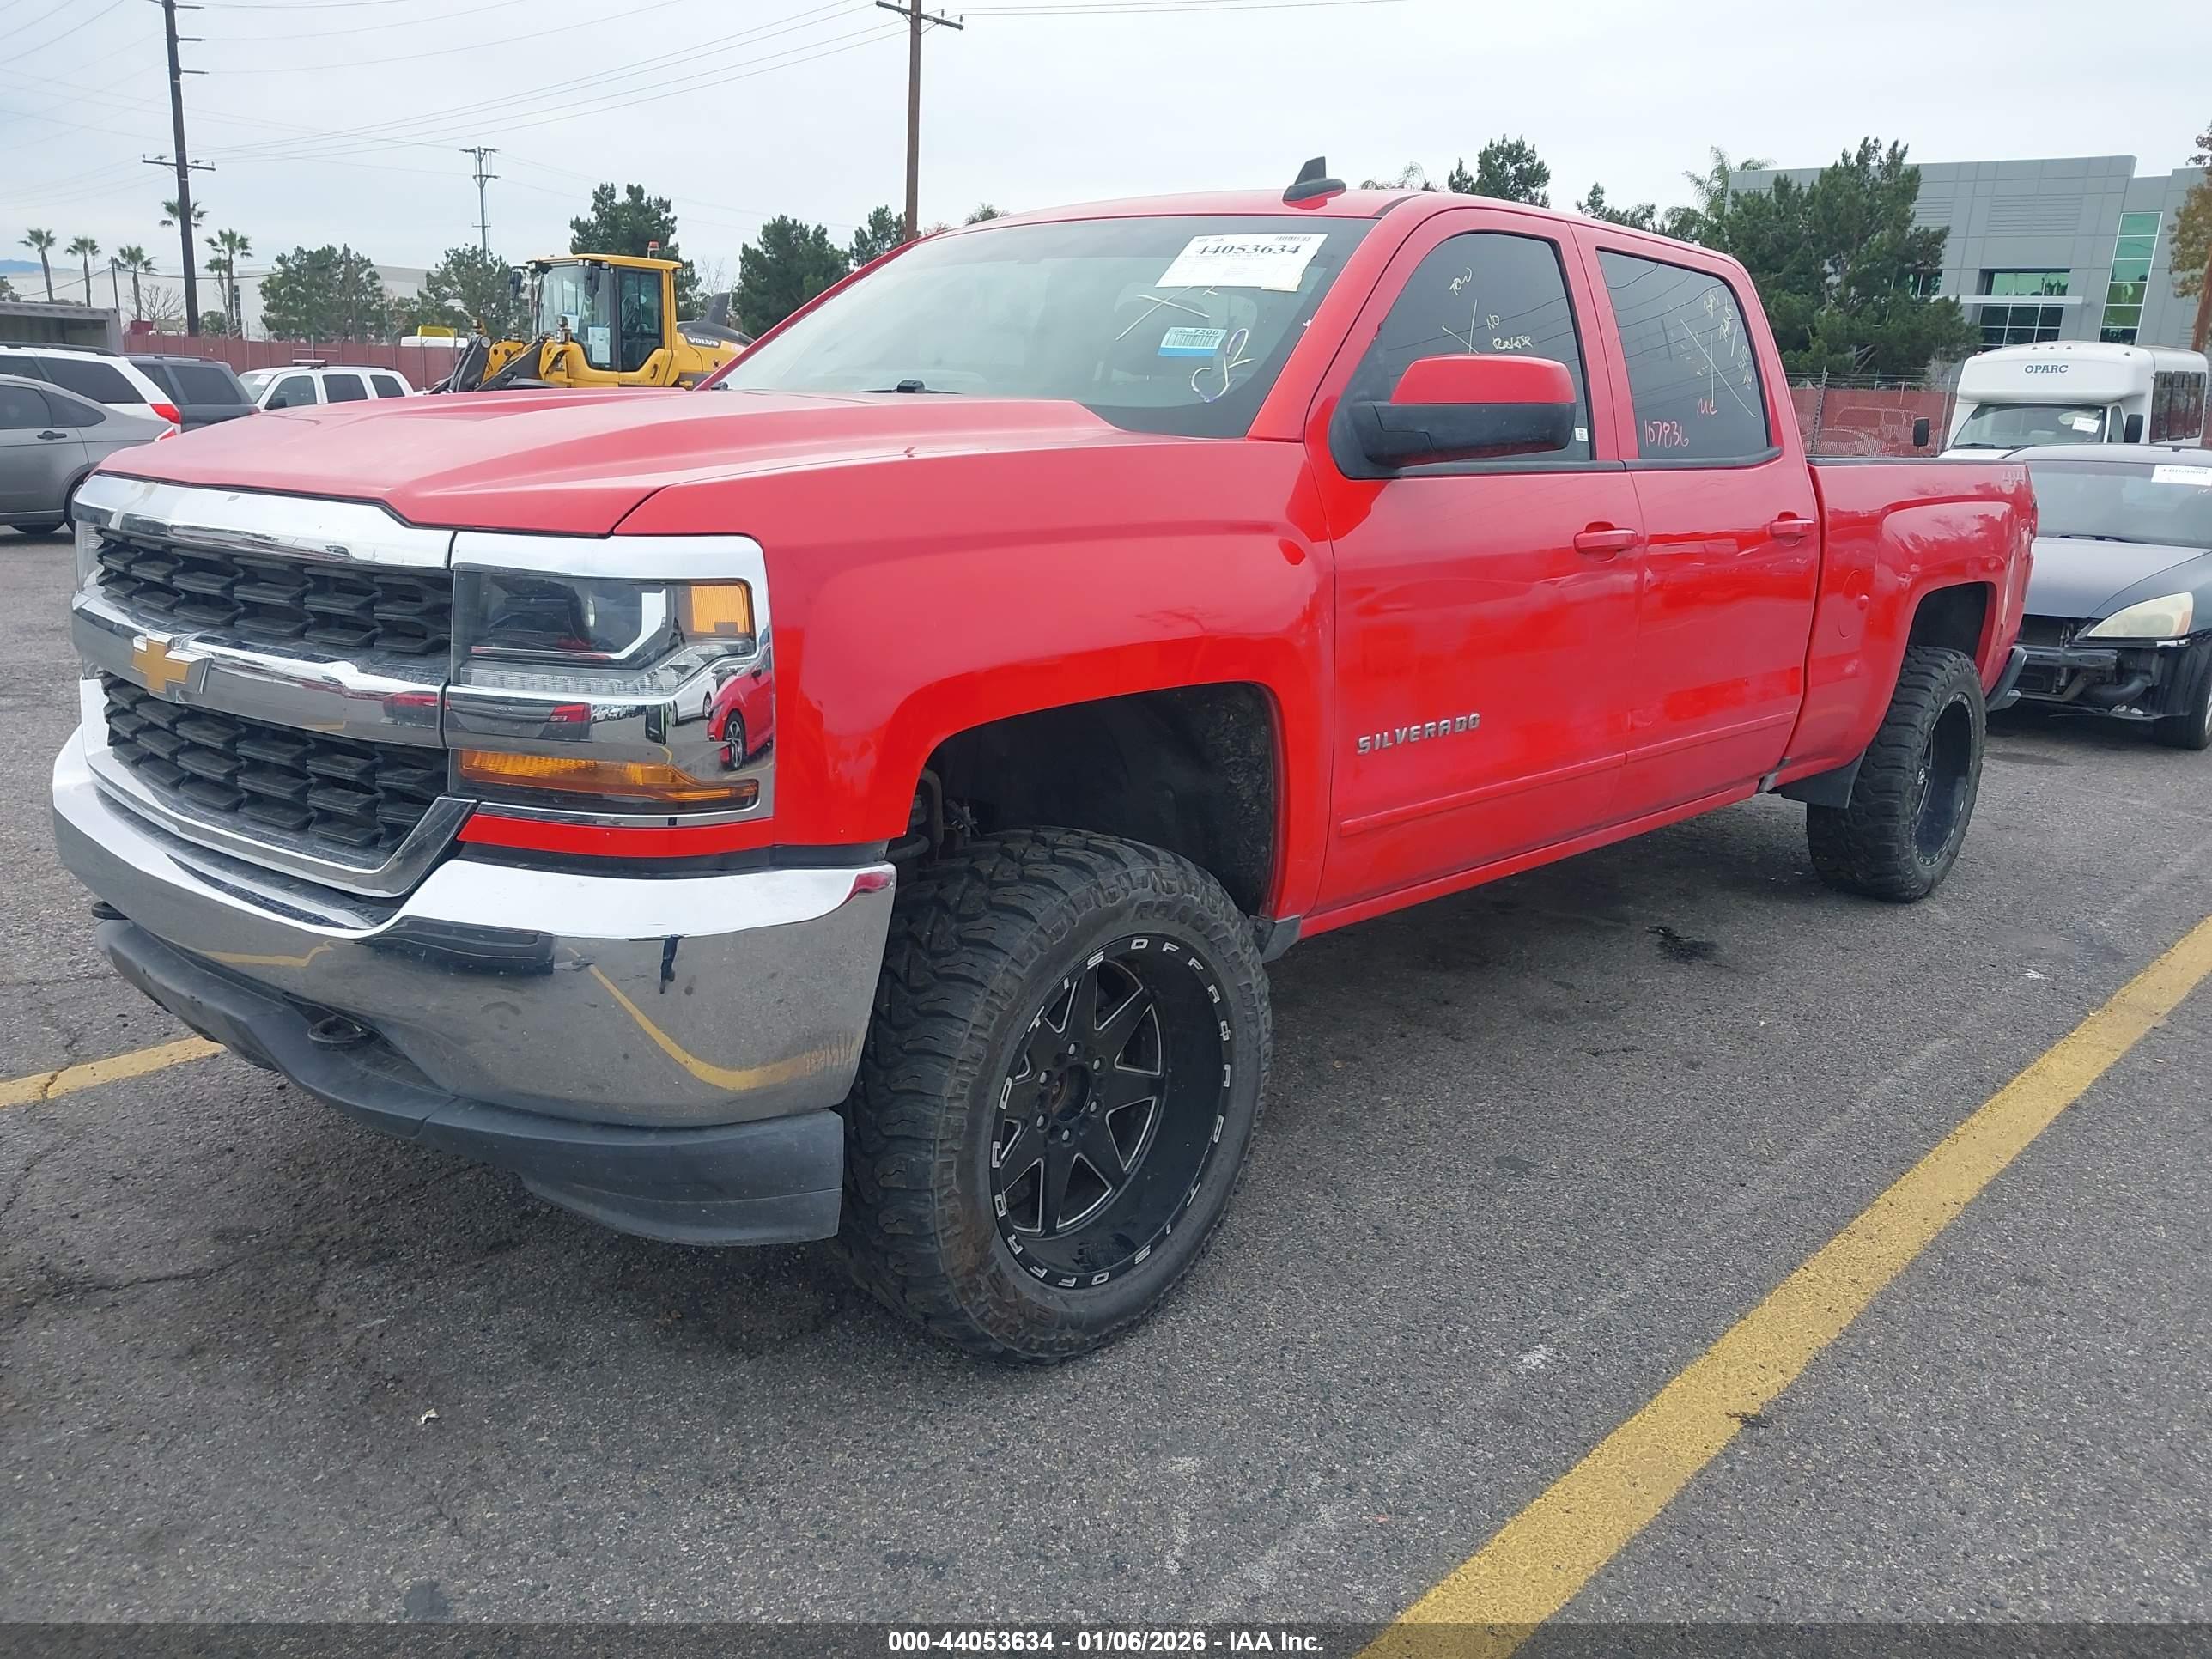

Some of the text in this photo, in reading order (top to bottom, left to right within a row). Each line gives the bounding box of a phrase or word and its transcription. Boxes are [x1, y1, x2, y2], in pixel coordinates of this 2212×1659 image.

[1194, 244, 1303, 255] 44053634
[1486, 313, 1500, 331] NO
[687, 337, 719, 346] VOLVO
[2024, 364, 2069, 374] OPARC
[1357, 713, 1480, 755] SILVERADO
